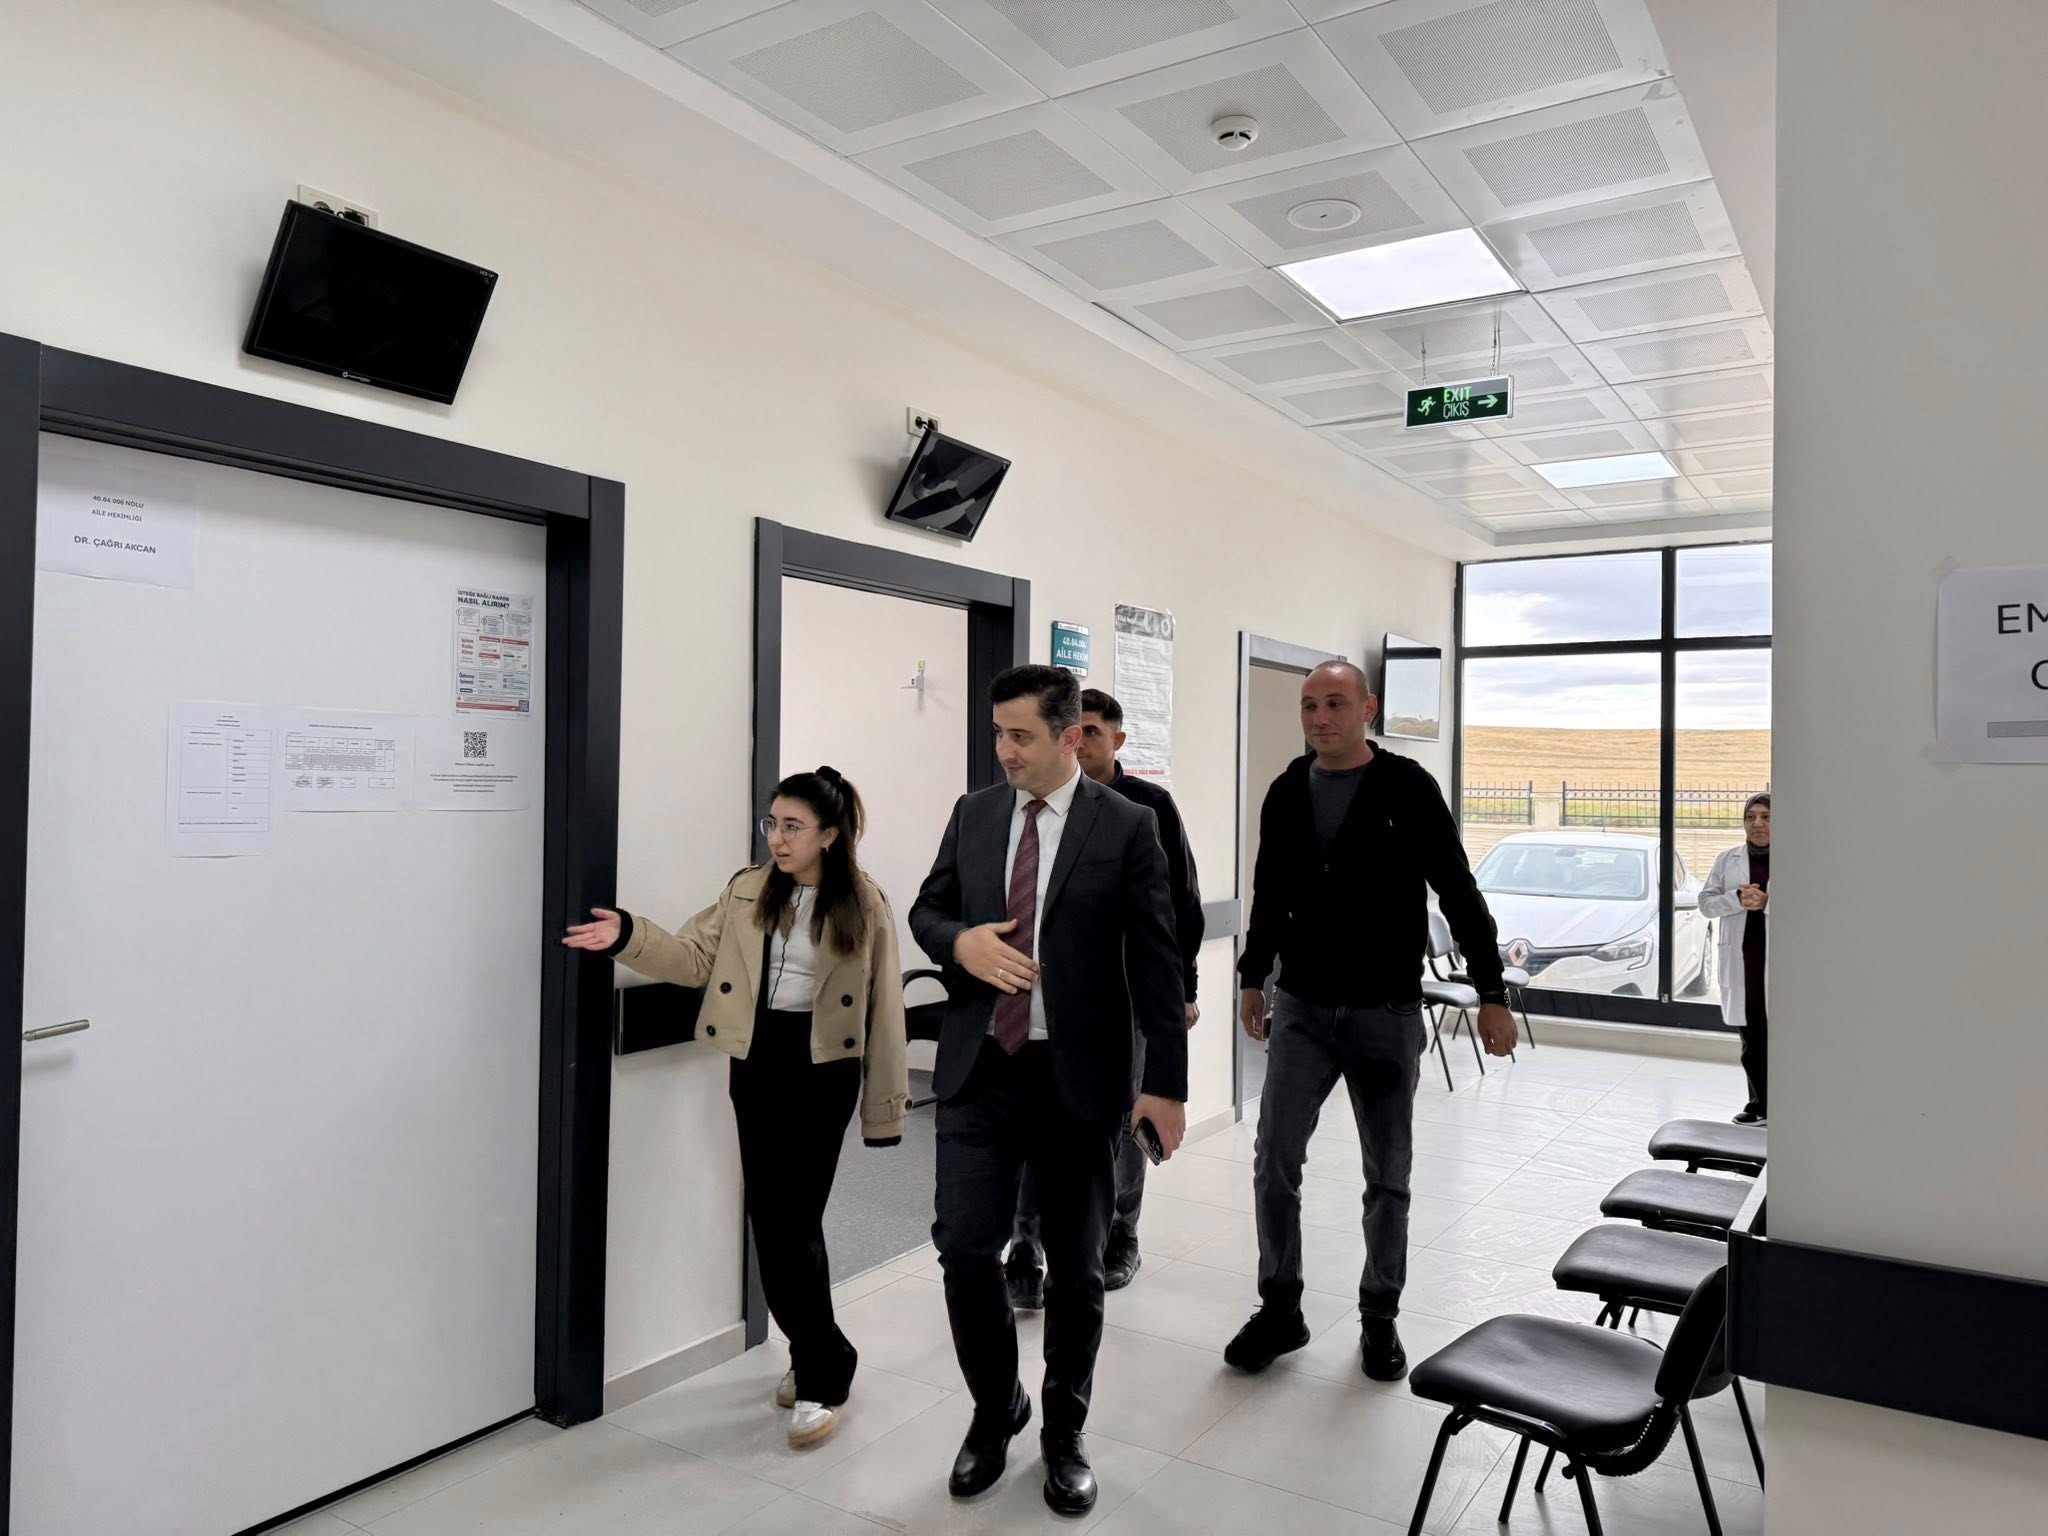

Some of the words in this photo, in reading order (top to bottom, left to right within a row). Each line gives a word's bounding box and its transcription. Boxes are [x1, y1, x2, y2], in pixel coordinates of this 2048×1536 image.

[1443, 386, 1472, 403] EXIT
[1443, 401, 1470, 419] ÇIKIŞ
[125, 500, 144, 509] NOLU
[91, 508, 106, 517] AİLE
[107, 511, 142, 522] HEKİMLİĞİ
[74, 535, 91, 545] DR.
[93, 537, 123, 550] ÇAĞRI
[124, 543, 156, 554] AKCAN
[457, 596, 480, 606] NASIL
[481, 599, 510, 609] ALIRIM?
[1056, 646, 1072, 660] AİLE
